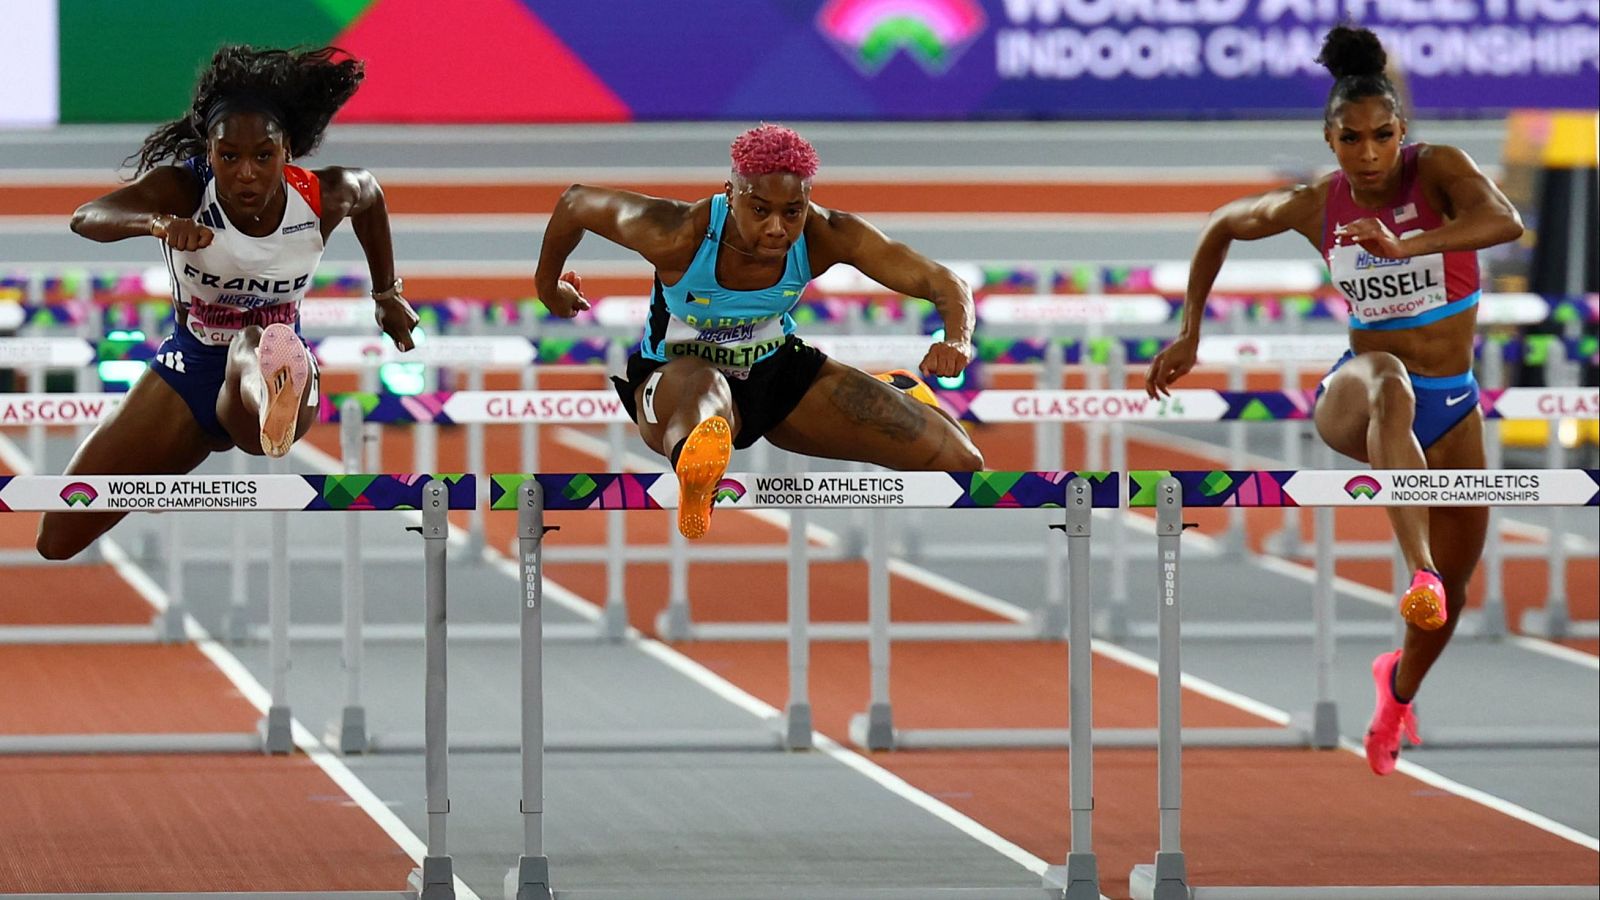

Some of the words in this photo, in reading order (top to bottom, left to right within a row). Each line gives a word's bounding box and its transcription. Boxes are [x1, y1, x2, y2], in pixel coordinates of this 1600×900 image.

[997, 28, 1202, 78] INDOOR
[184, 263, 309, 293] FRANCE
[1339, 268, 1438, 302] RUSSELL
[1363, 297, 1425, 318] GLASGOW
[1428, 293, 1442, 304] 24
[672, 341, 779, 367] CHARLTON
[3, 401, 104, 420] ASGOW
[486, 397, 620, 417] GLASGOW
[1012, 396, 1148, 417] GLASGOW
[1156, 398, 1185, 416] 24
[108, 481, 166, 495] WORLD
[170, 480, 257, 494] ATHLETICS
[756, 478, 814, 492] WORLD
[818, 477, 904, 491] ATHLETICS
[1391, 475, 1449, 489] WORLD
[1453, 474, 1540, 488] ATHLETICS
[107, 497, 155, 508] INDOOR
[157, 496, 258, 508] CHAMPIONSHIPS
[755, 494, 802, 505] INDOOR
[804, 493, 904, 505] CHAMPIONSHIPS
[1391, 490, 1437, 501] INDOOR
[1440, 490, 1540, 501] CHAMPIONSHIPS
[525, 565, 537, 609] MONDO
[1164, 562, 1176, 606] MONDO
